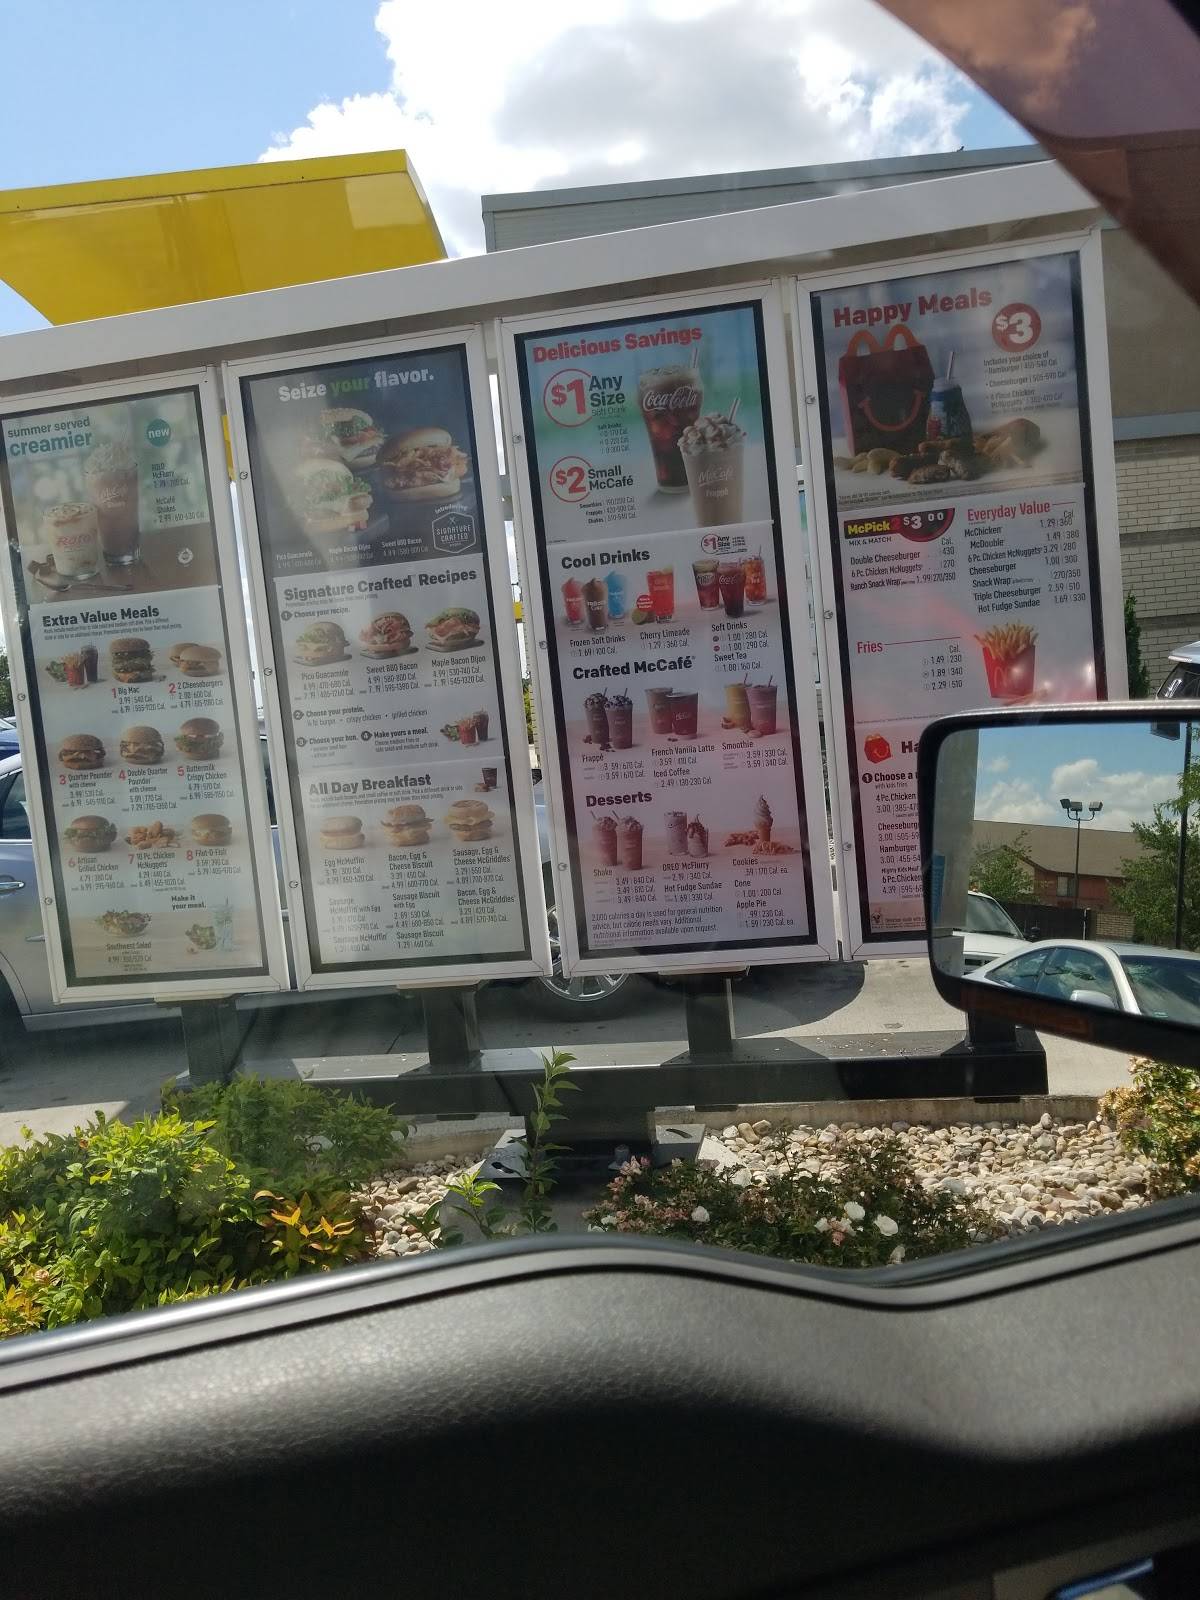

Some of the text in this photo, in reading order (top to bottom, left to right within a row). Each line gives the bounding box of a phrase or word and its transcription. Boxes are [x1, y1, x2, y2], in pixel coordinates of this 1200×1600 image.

[833, 287, 992, 328] Happy Meals
[996, 311, 1034, 343] $3
[533, 327, 702, 363] Delicious Savings
[278, 368, 434, 402] Seize your flavor.
[589, 375, 623, 391] Any
[551, 379, 587, 415] $1
[590, 392, 625, 407] Size
[8, 417, 90, 438] summer served
[148, 428, 170, 438] new
[9, 431, 93, 456] creamier
[588, 465, 622, 479] Small
[556, 466, 586, 493] $2
[589, 475, 633, 491] McCafé
[967, 502, 1050, 523] Everyday Value
[436, 524, 471, 536] SIGNATURE
[848, 521, 891, 534] McPick
[562, 549, 650, 569] Cool Drinks
[850, 551, 920, 566] Double Cheeseburger
[984, 551, 1006, 561] Chicken
[866, 566, 888, 575] Chicken
[969, 562, 1016, 575] Cheeseburger
[284, 582, 354, 601] Signature
[358, 575, 412, 592] Crafted
[419, 570, 477, 587] Recipes
[850, 581, 866, 591] Ranch
[867, 580, 884, 589] Snack
[973, 579, 992, 587] Snack
[974, 587, 1041, 601] Triple Cheeseburger
[978, 598, 1040, 612] Hot Fudge Sundae
[42, 606, 159, 627] Extra Value Meals
[712, 622, 747, 632] Soft Drinks
[570, 638, 591, 647] Frozen
[606, 635, 625, 644] Drinks
[640, 632, 661, 640] Cherry
[857, 641, 883, 654] Fries
[714, 652, 747, 663] Sweet Tea
[366, 665, 385, 674] Sweet
[573, 656, 693, 680] Crafted McCafé
[169, 683, 176, 694] 2
[374, 731, 389, 739] Make
[722, 740, 753, 750] Smoothie
[651, 747, 673, 757] French
[119, 771, 126, 780] 4
[177, 766, 184, 776] 5
[60, 775, 66, 784] 3
[874, 773, 906, 782] Choose
[309, 774, 432, 796] All Day Breakfast
[586, 792, 653, 808] Desserts
[891, 792, 916, 801] Chicken
[880, 844, 917, 854] Hamburger
[186, 850, 193, 861] 8
[733, 857, 758, 867] Cookies
[664, 881, 722, 893] Hot Fudge Sundae
[734, 879, 751, 888] Cone
[737, 900, 766, 909] Apple Pie
